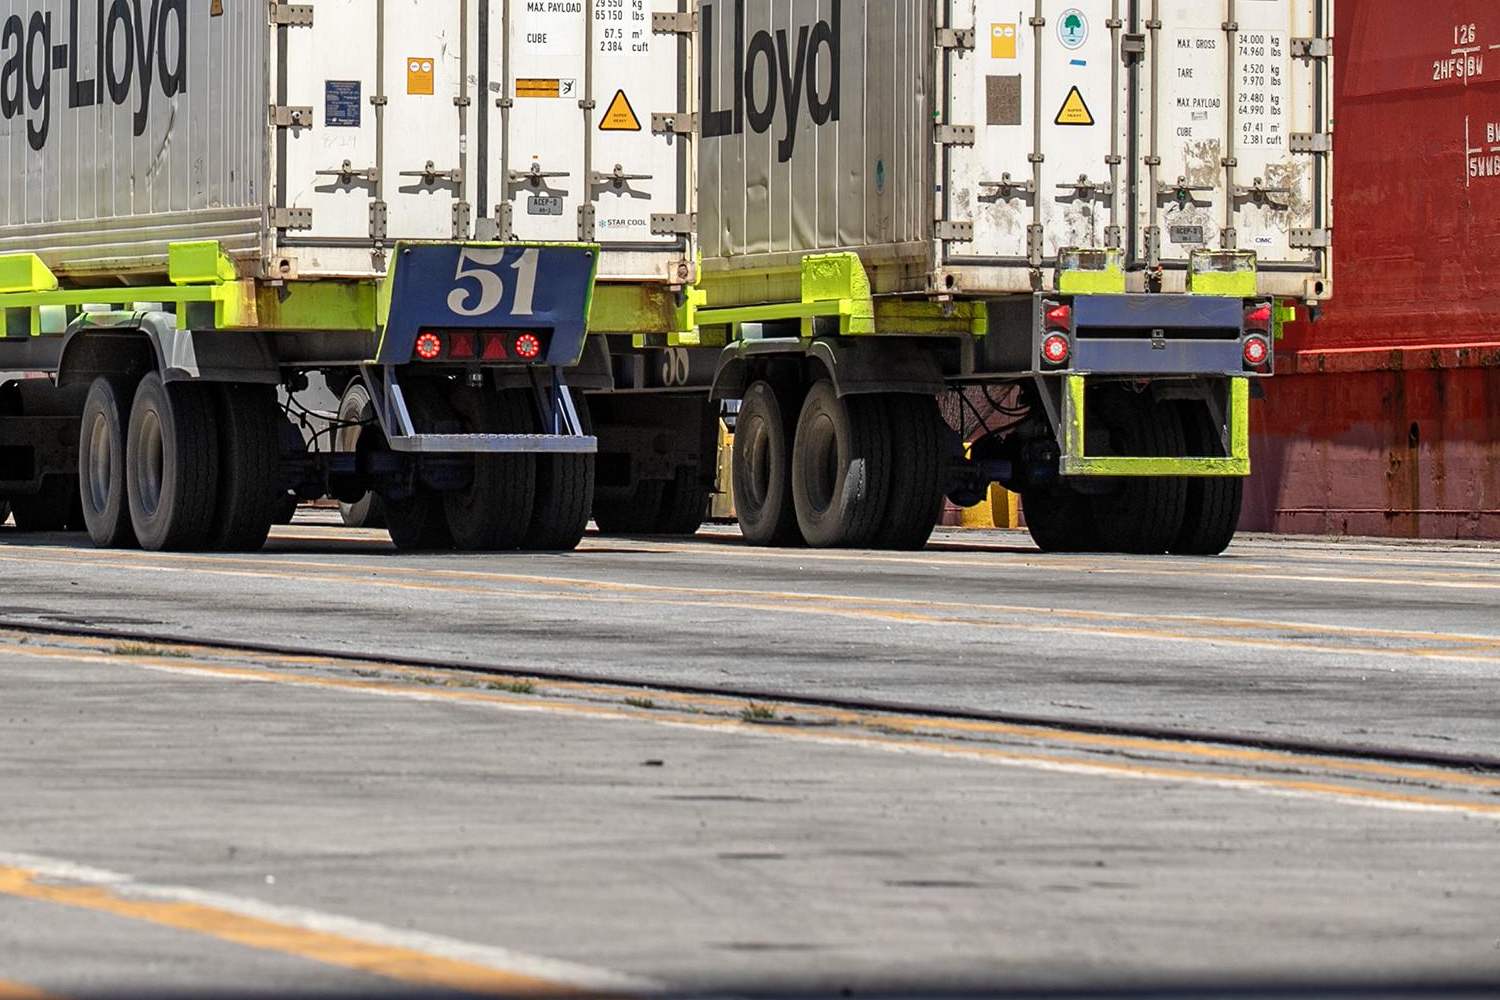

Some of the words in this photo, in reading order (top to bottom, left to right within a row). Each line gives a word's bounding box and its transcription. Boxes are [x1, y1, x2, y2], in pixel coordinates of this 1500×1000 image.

[527, 2, 546, 12] MAX.
[548, 2, 582, 13] PAYLOAD
[632, 11, 645, 20] lbs
[527, 33, 547, 43] CUBE
[604, 28, 623, 39] 67.5
[1453, 23, 1476, 44] 126
[632, 42, 649, 52] cuft
[1196, 39, 1216, 49] GROSS
[1239, 35, 1264, 44] 34.000
[1270, 35, 1280, 47] kg
[1238, 47, 1264, 56] 74.960
[1270, 47, 1282, 57] lbs
[1177, 68, 1193, 78] TARE
[1243, 64, 1264, 74] 4.520
[1270, 64, 1280, 76] kg
[1243, 76, 1264, 86] 9.970
[1270, 76, 1282, 86] lbs
[1238, 93, 1264, 103] 29.480
[1270, 94, 1280, 105] kg
[1238, 105, 1264, 115] 64.990
[1270, 106, 1282, 115] lbs
[1176, 127, 1192, 137] CUBE
[1242, 122, 1263, 132] 67.41
[1243, 135, 1263, 144] 2.381
[1266, 135, 1282, 144] cuft
[447, 247, 539, 317] 51
